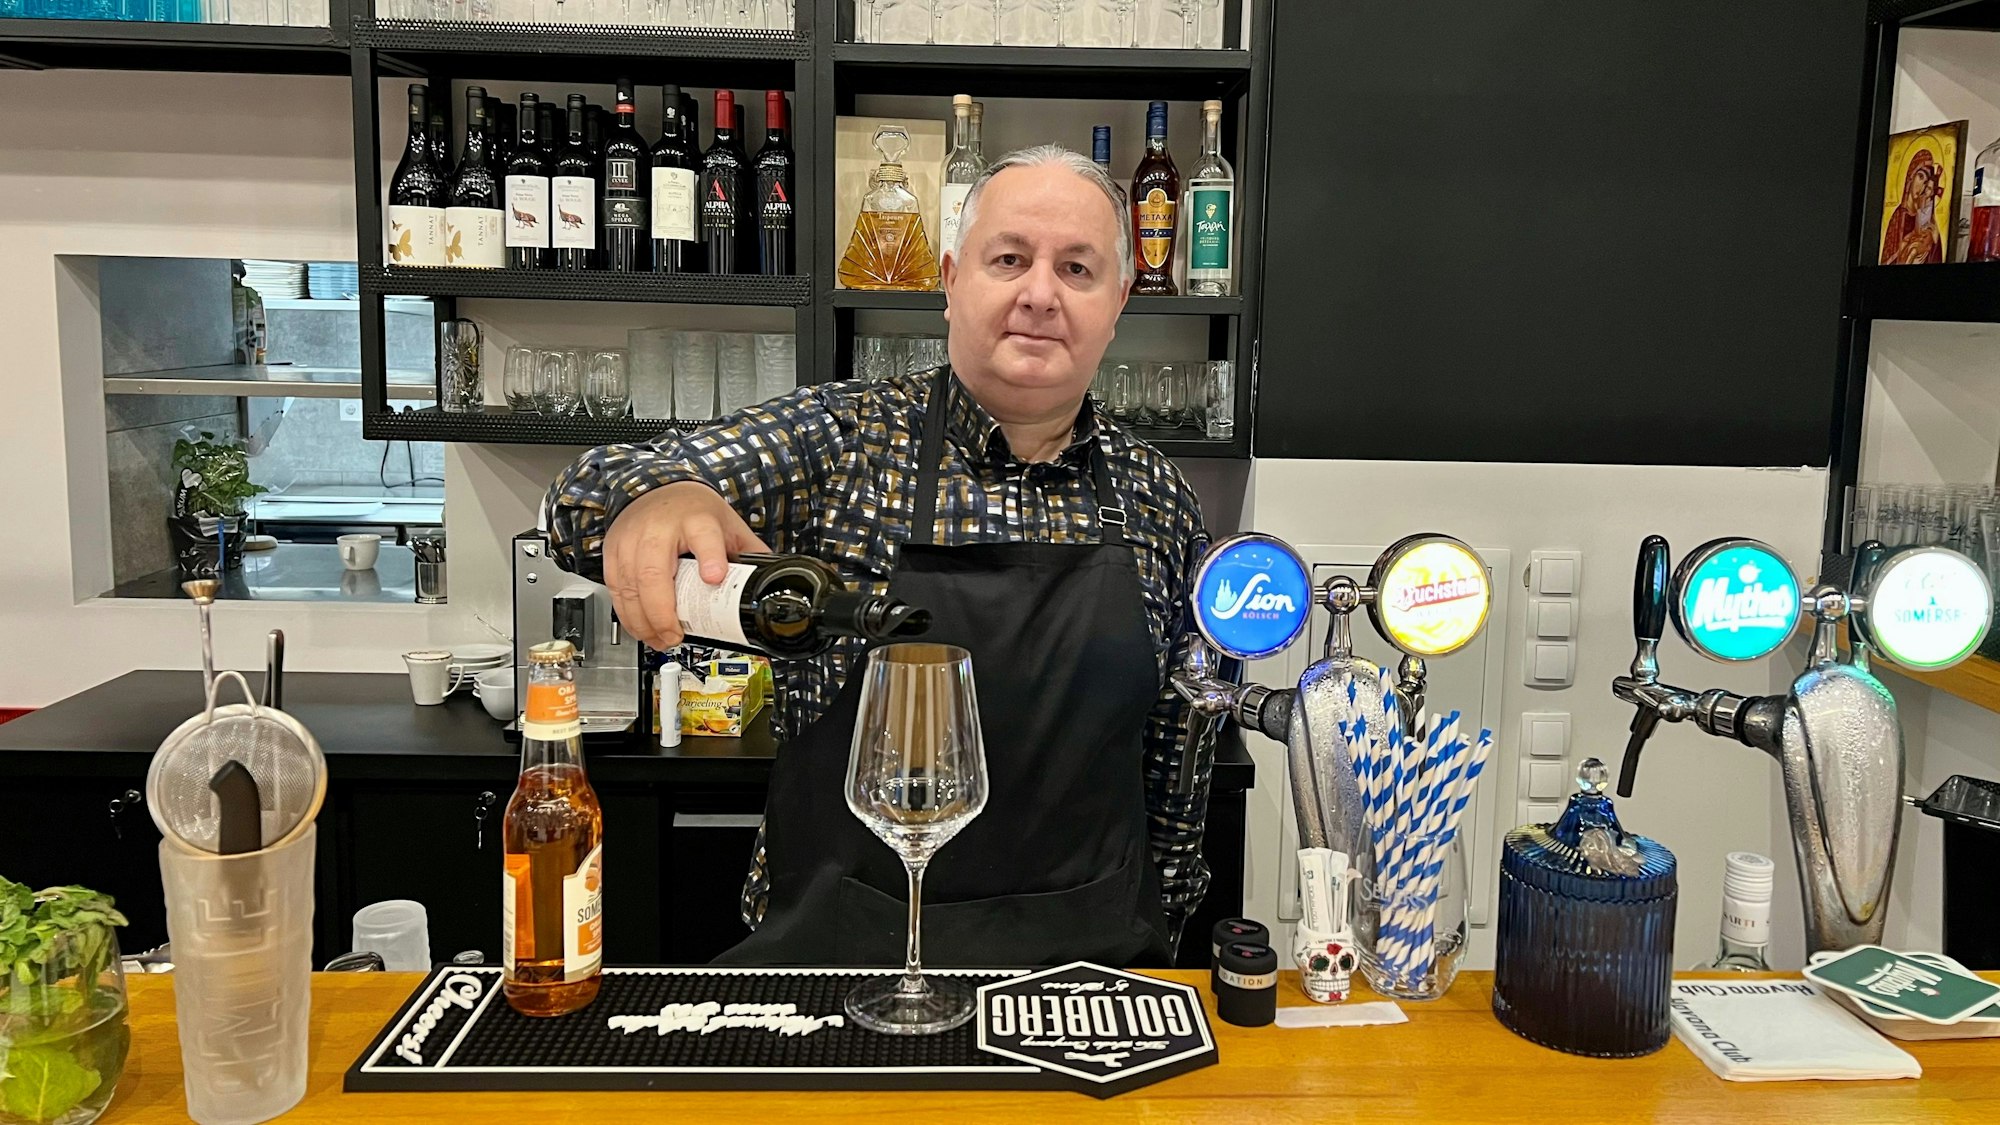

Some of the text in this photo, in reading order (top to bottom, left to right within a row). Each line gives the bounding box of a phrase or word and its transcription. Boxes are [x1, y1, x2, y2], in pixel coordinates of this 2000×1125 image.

[704, 201, 731, 209] ALPHA
[764, 202, 792, 211] ALPHA
[1139, 212, 1174, 222] METAXA
[1210, 573, 1296, 619] Sion
[677, 697, 722, 711] Darjeeling
[1678, 984, 1816, 997] Havana Club
[396, 972, 484, 1066] Cheers!
[991, 993, 1193, 1037] GOLDBERG
[1713, 1040, 1753, 1064] Club
